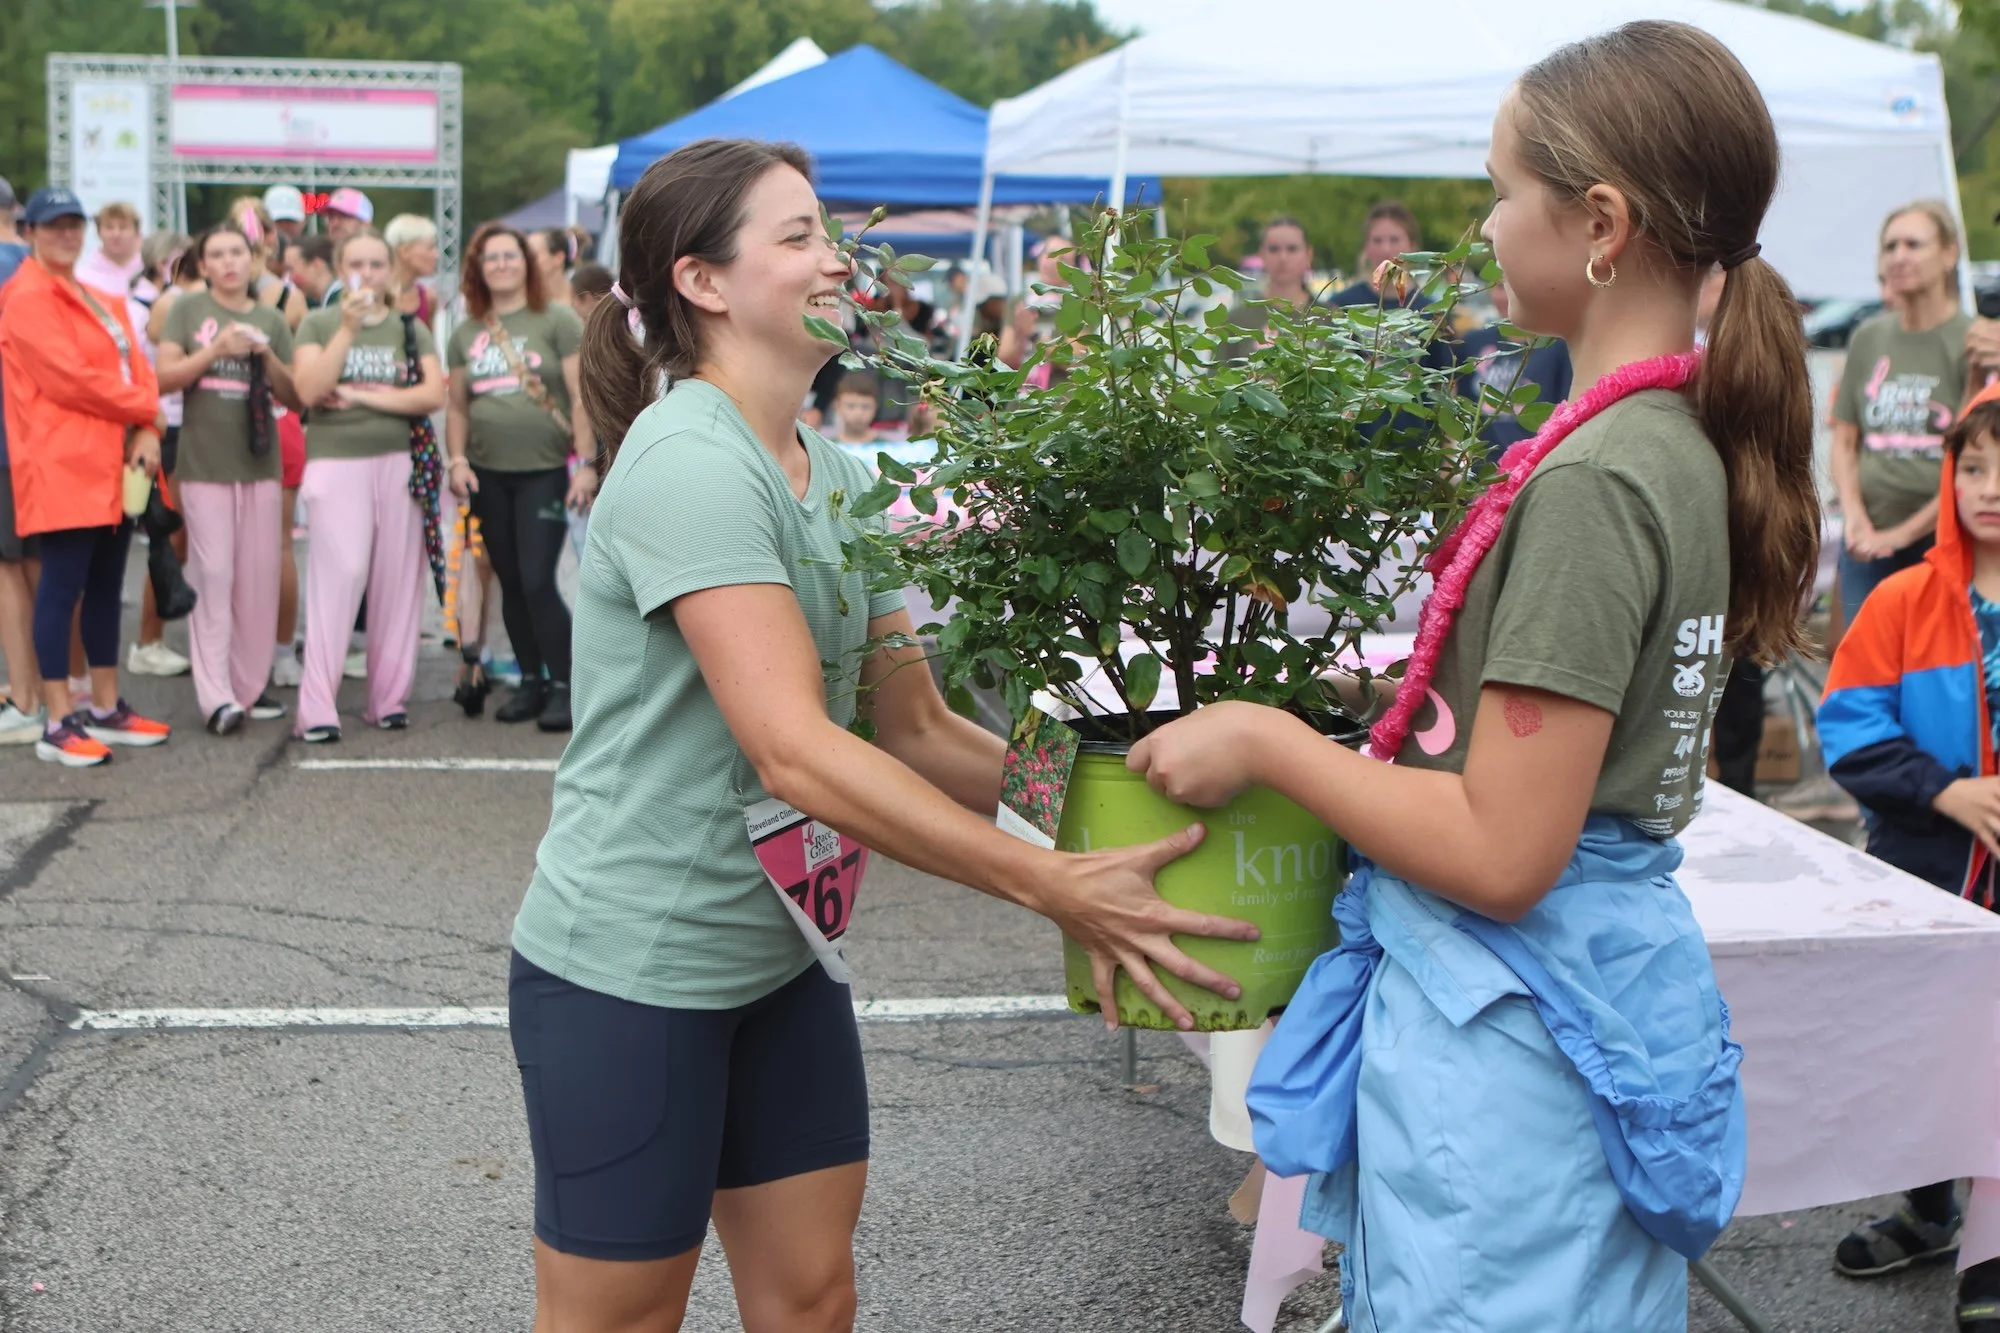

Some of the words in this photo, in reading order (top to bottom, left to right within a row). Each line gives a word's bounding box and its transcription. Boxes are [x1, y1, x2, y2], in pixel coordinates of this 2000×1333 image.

[1663, 709, 1686, 719] YOUR
[749, 814, 779, 833] Cleveland
[1229, 810, 1257, 825] the
[815, 830, 832, 849] Race
[811, 842, 833, 858] Grace
[1231, 890, 1279, 908] family
[1284, 886, 1300, 902] of
